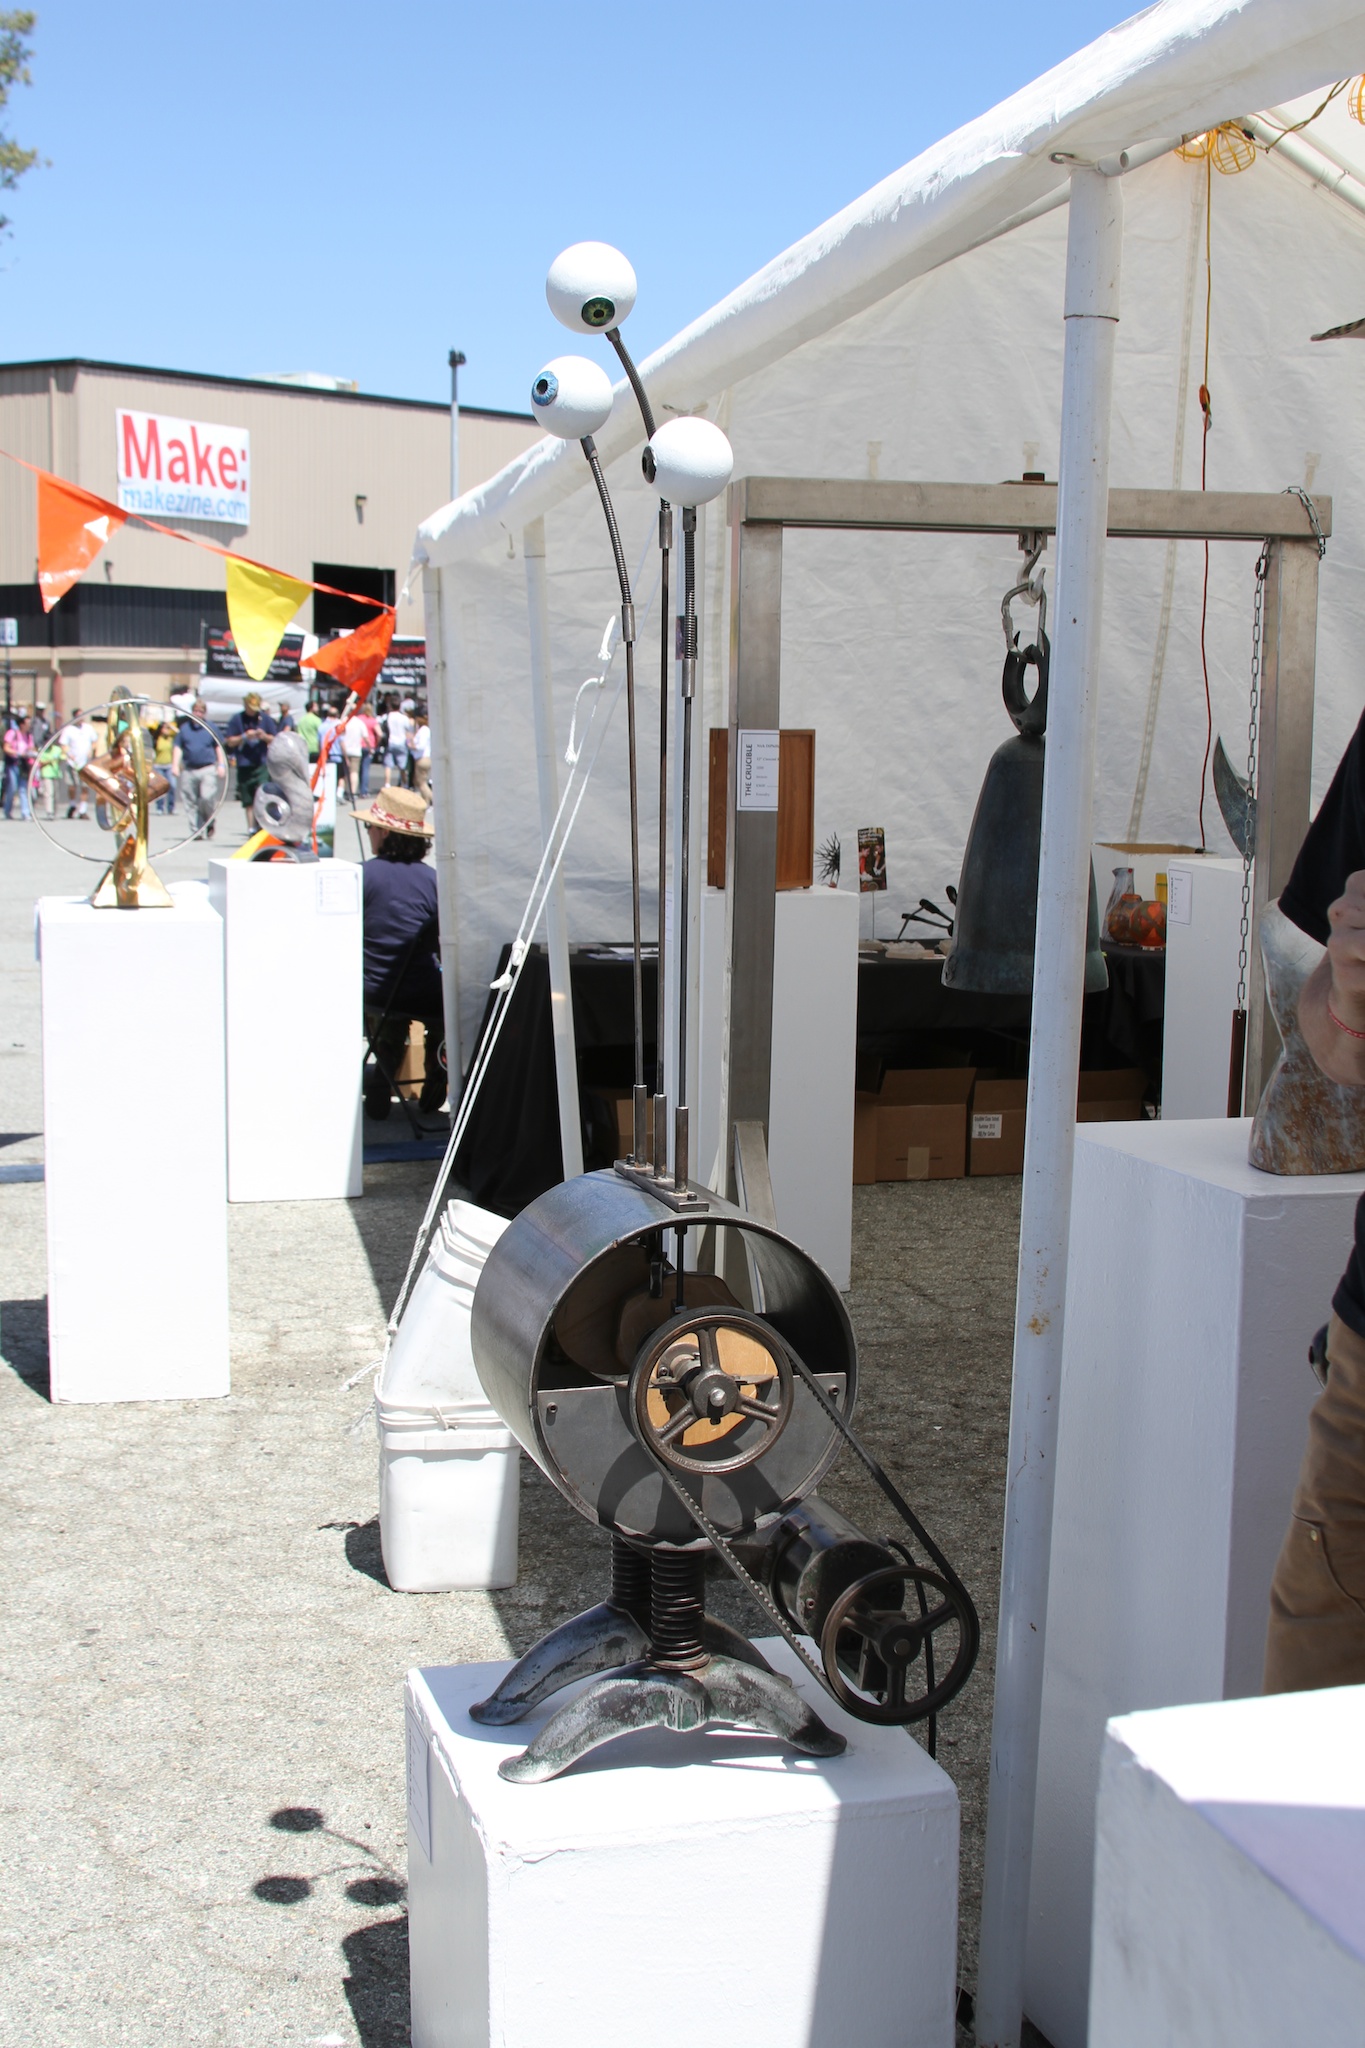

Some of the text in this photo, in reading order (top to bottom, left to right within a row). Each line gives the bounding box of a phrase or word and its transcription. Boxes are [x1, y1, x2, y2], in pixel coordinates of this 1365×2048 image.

[122, 414, 246, 492] Make:
[122, 484, 247, 519] makezine.com
[745, 743, 753, 780] CRUCIBLE
